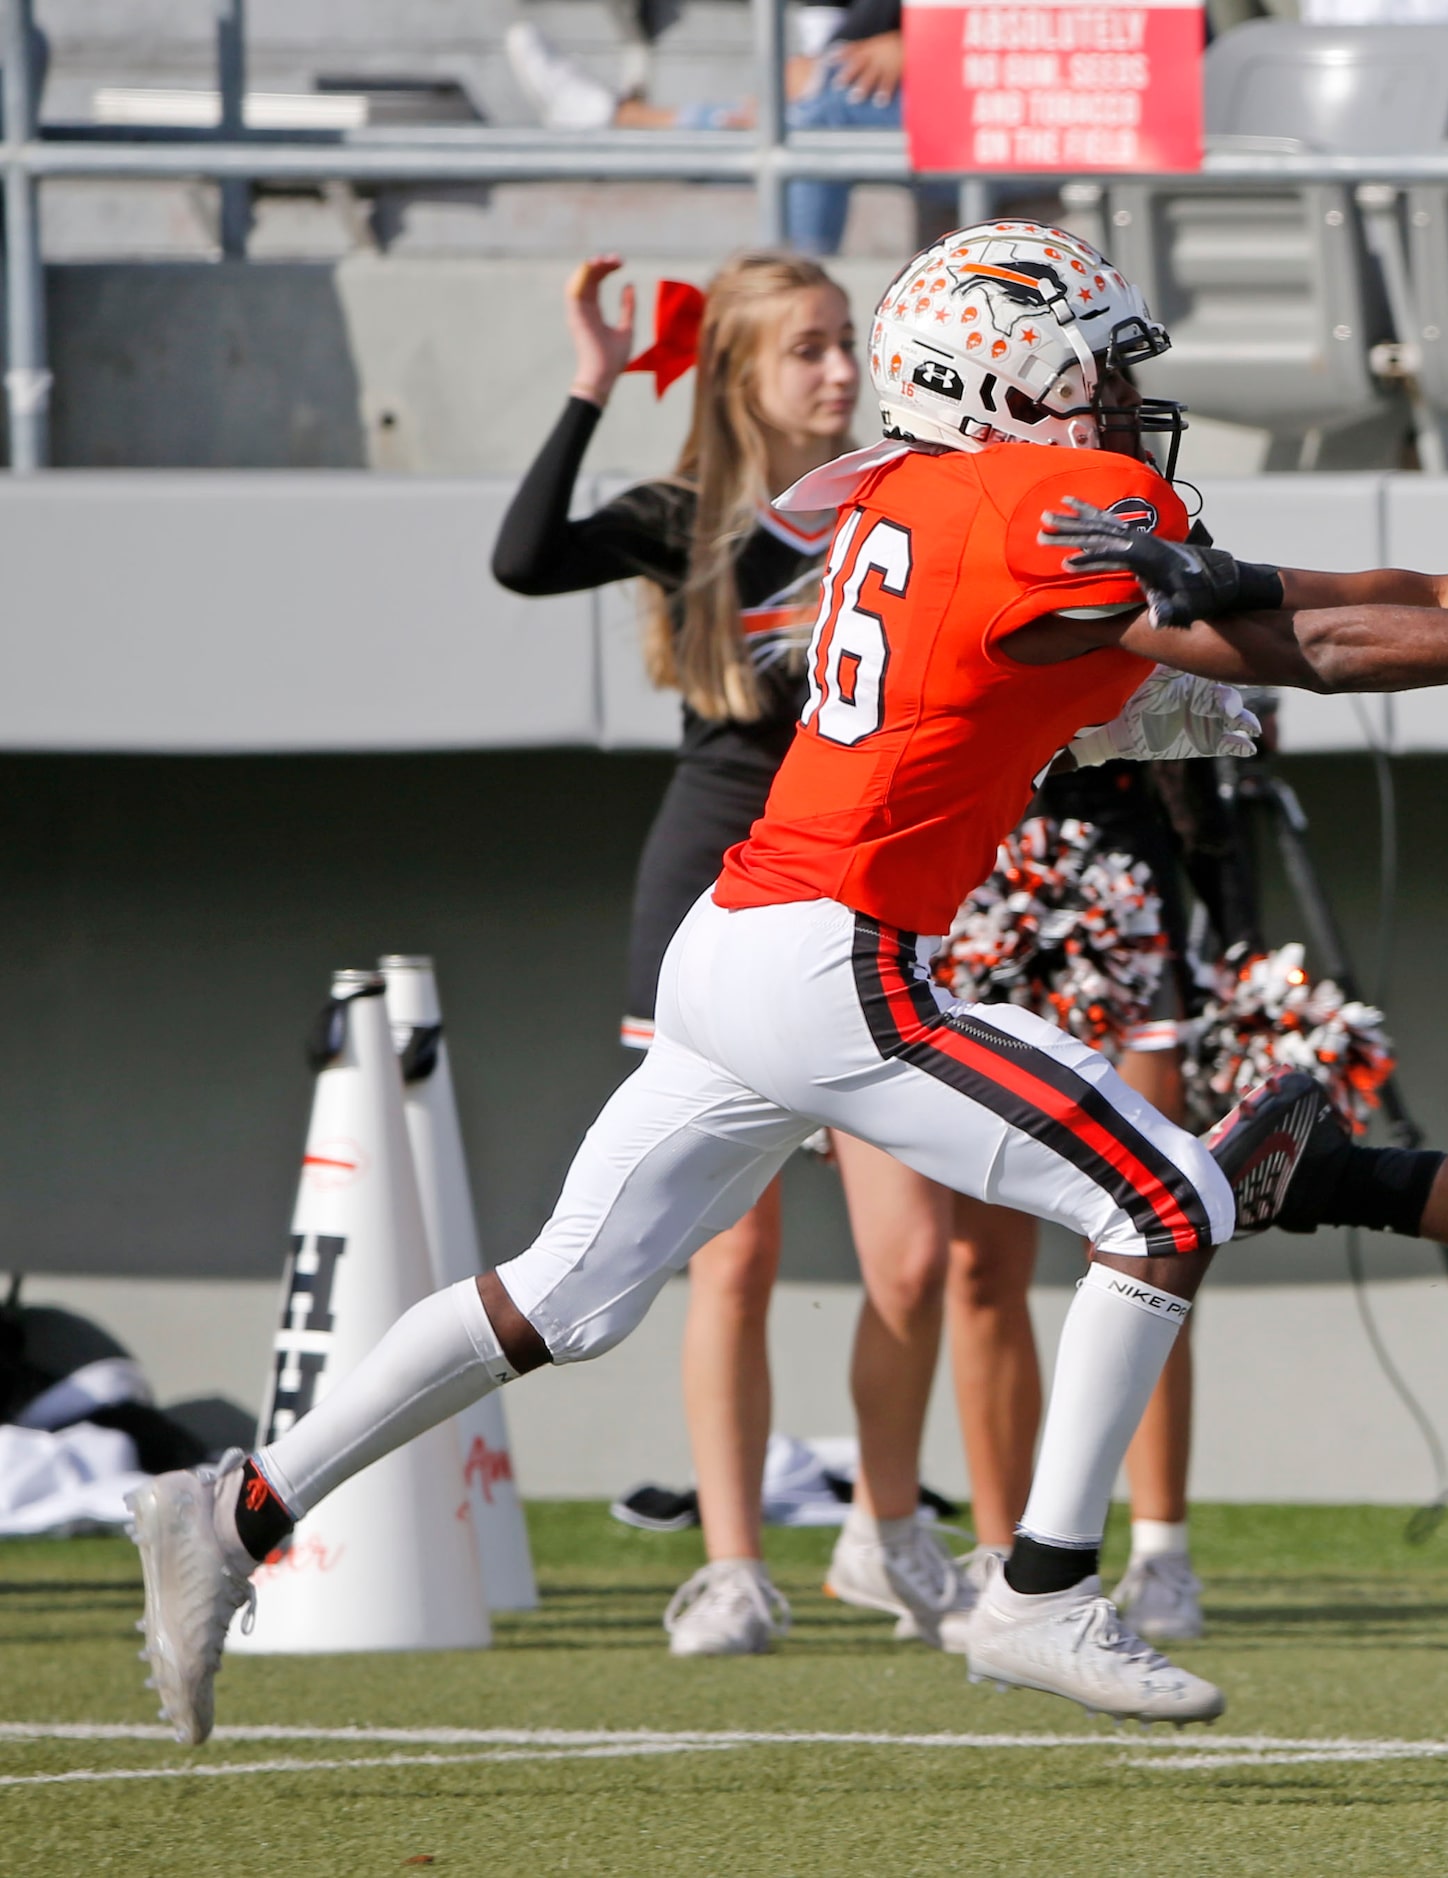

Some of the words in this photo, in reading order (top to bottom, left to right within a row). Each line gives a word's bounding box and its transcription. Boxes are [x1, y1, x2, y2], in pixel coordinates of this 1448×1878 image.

[962, 9, 1148, 50] ABSOLUTELY
[962, 52, 1000, 88] NO
[1069, 52, 1149, 89] SEEDS
[972, 90, 1025, 125] AND
[1029, 90, 1140, 126] TOBACCO
[974, 128, 1010, 164] ON
[1014, 128, 1059, 164] THE
[1063, 128, 1138, 164] FIELD
[900, 381, 916, 397] 16
[800, 506, 913, 748] 16
[1108, 1280, 1166, 1309] NIKE
